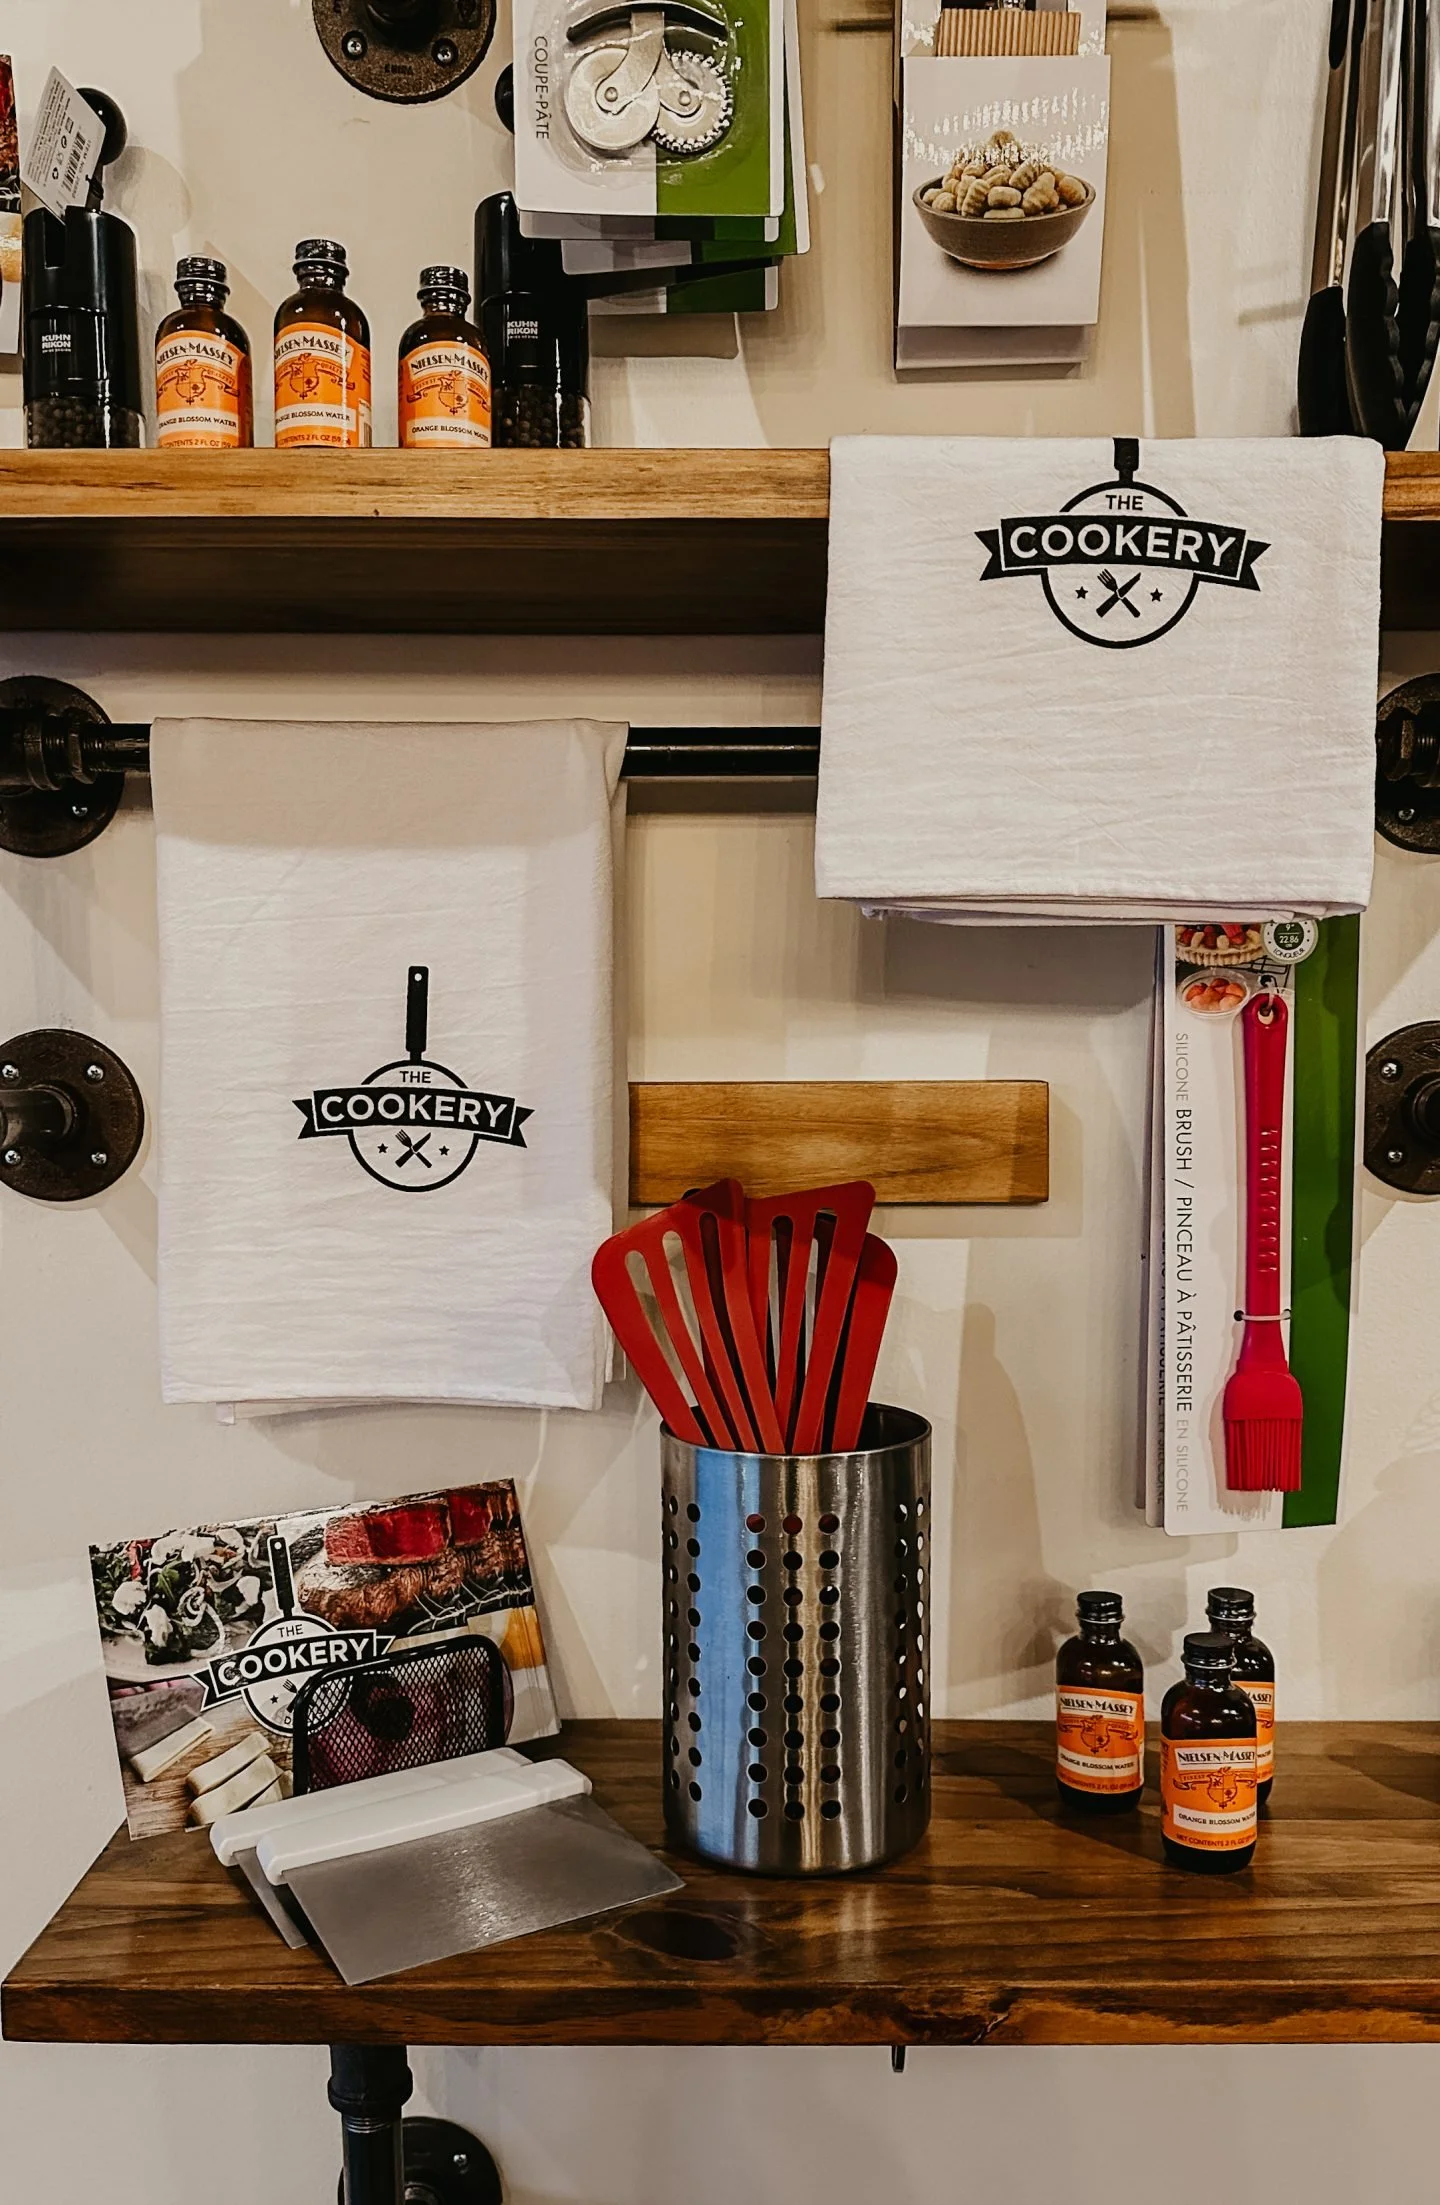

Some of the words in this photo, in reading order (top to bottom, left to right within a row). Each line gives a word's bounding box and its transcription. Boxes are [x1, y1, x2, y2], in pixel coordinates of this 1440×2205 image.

[533, 36, 552, 139] COUPE-PÂTE
[42, 341, 71, 349] RIKON
[214, 417, 236, 428] WATER
[412, 425, 438, 433] ORANGE
[440, 425, 472, 435] BLOSSOM
[1106, 494, 1144, 510] THE
[1010, 523, 1236, 567] COOKERY
[1280, 936, 1299, 944] 22.86
[1176, 1032, 1189, 1102] SILICONE
[400, 1071, 431, 1084] THE
[321, 1093, 507, 1128] COOKERY
[1176, 1109, 1192, 1170] BRUSH
[1174, 1178, 1195, 1188] /
[1176, 1198, 1192, 1281] PINCEAU
[1176, 1289, 1197, 1304] À
[1176, 1312, 1197, 1412] PÂTISSERIE
[1176, 1420, 1188, 1439] EN
[1176, 1446, 1188, 1512] SILICONE
[277, 1624, 304, 1638] THE
[218, 1637, 370, 1686] COOKERY
[1082, 1762, 1113, 1770] BLOSSOM
[1178, 1813, 1206, 1824] ORANGE
[1189, 1836, 1224, 1847] CONTENTS
